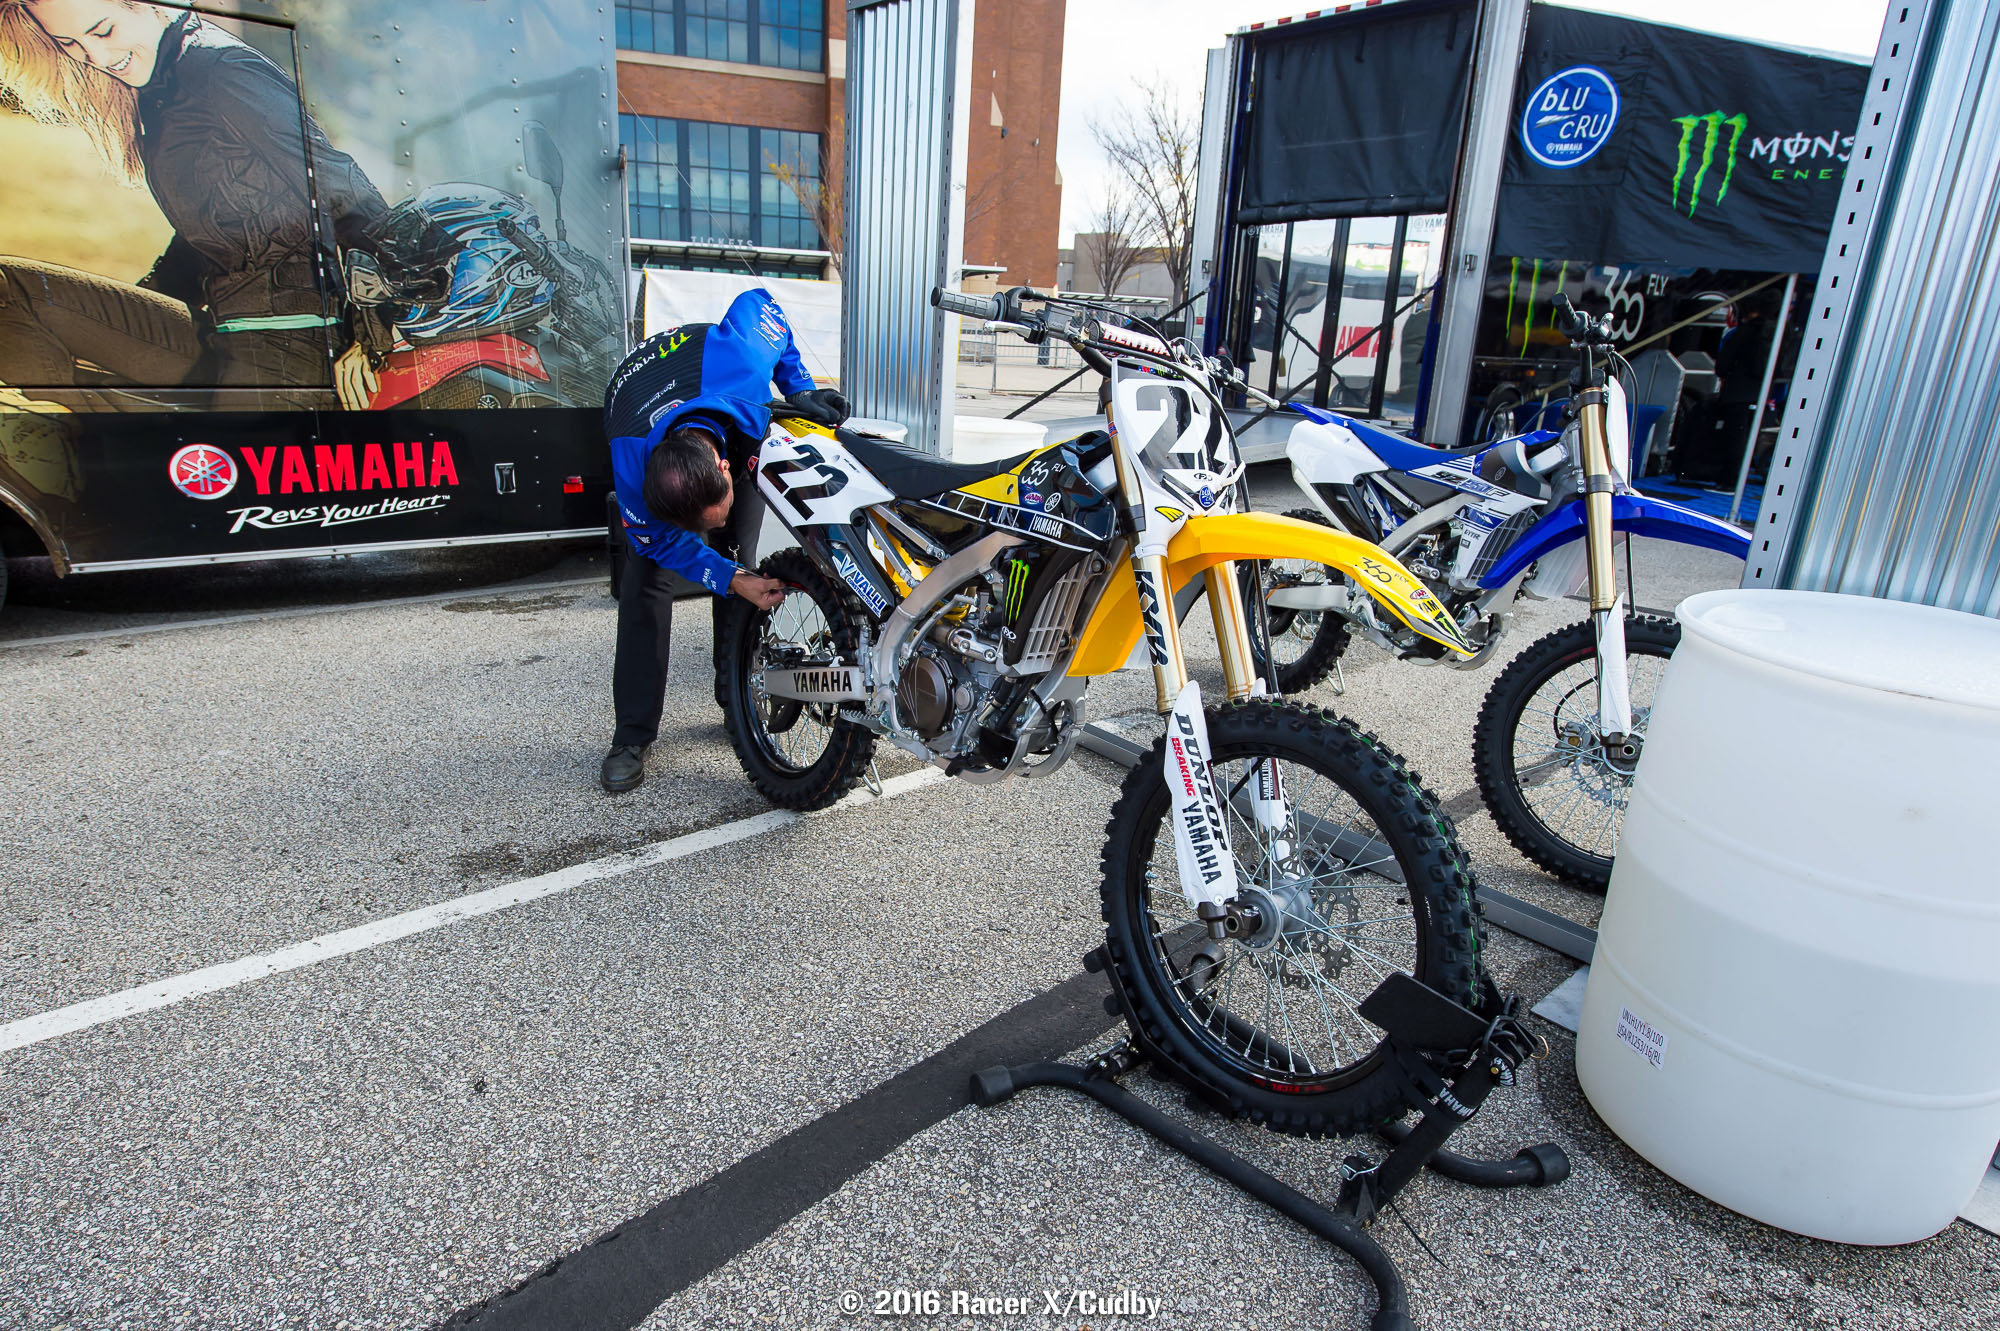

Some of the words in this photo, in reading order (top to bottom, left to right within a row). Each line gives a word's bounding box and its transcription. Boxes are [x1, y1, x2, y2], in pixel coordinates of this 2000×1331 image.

[691, 236, 754, 248] TICKETS
[1647, 274, 1669, 296] FLY
[240, 441, 460, 495] YAMAHA
[760, 444, 849, 522] 22
[1033, 515, 1064, 539] YAMAHA
[853, 570, 887, 612] VALLI
[793, 671, 853, 693] YAMAHA
[1170, 737, 1197, 798] BRAKING
[1174, 712, 1228, 851] DUNLOP
[1182, 800, 1222, 886] YAMAHA
